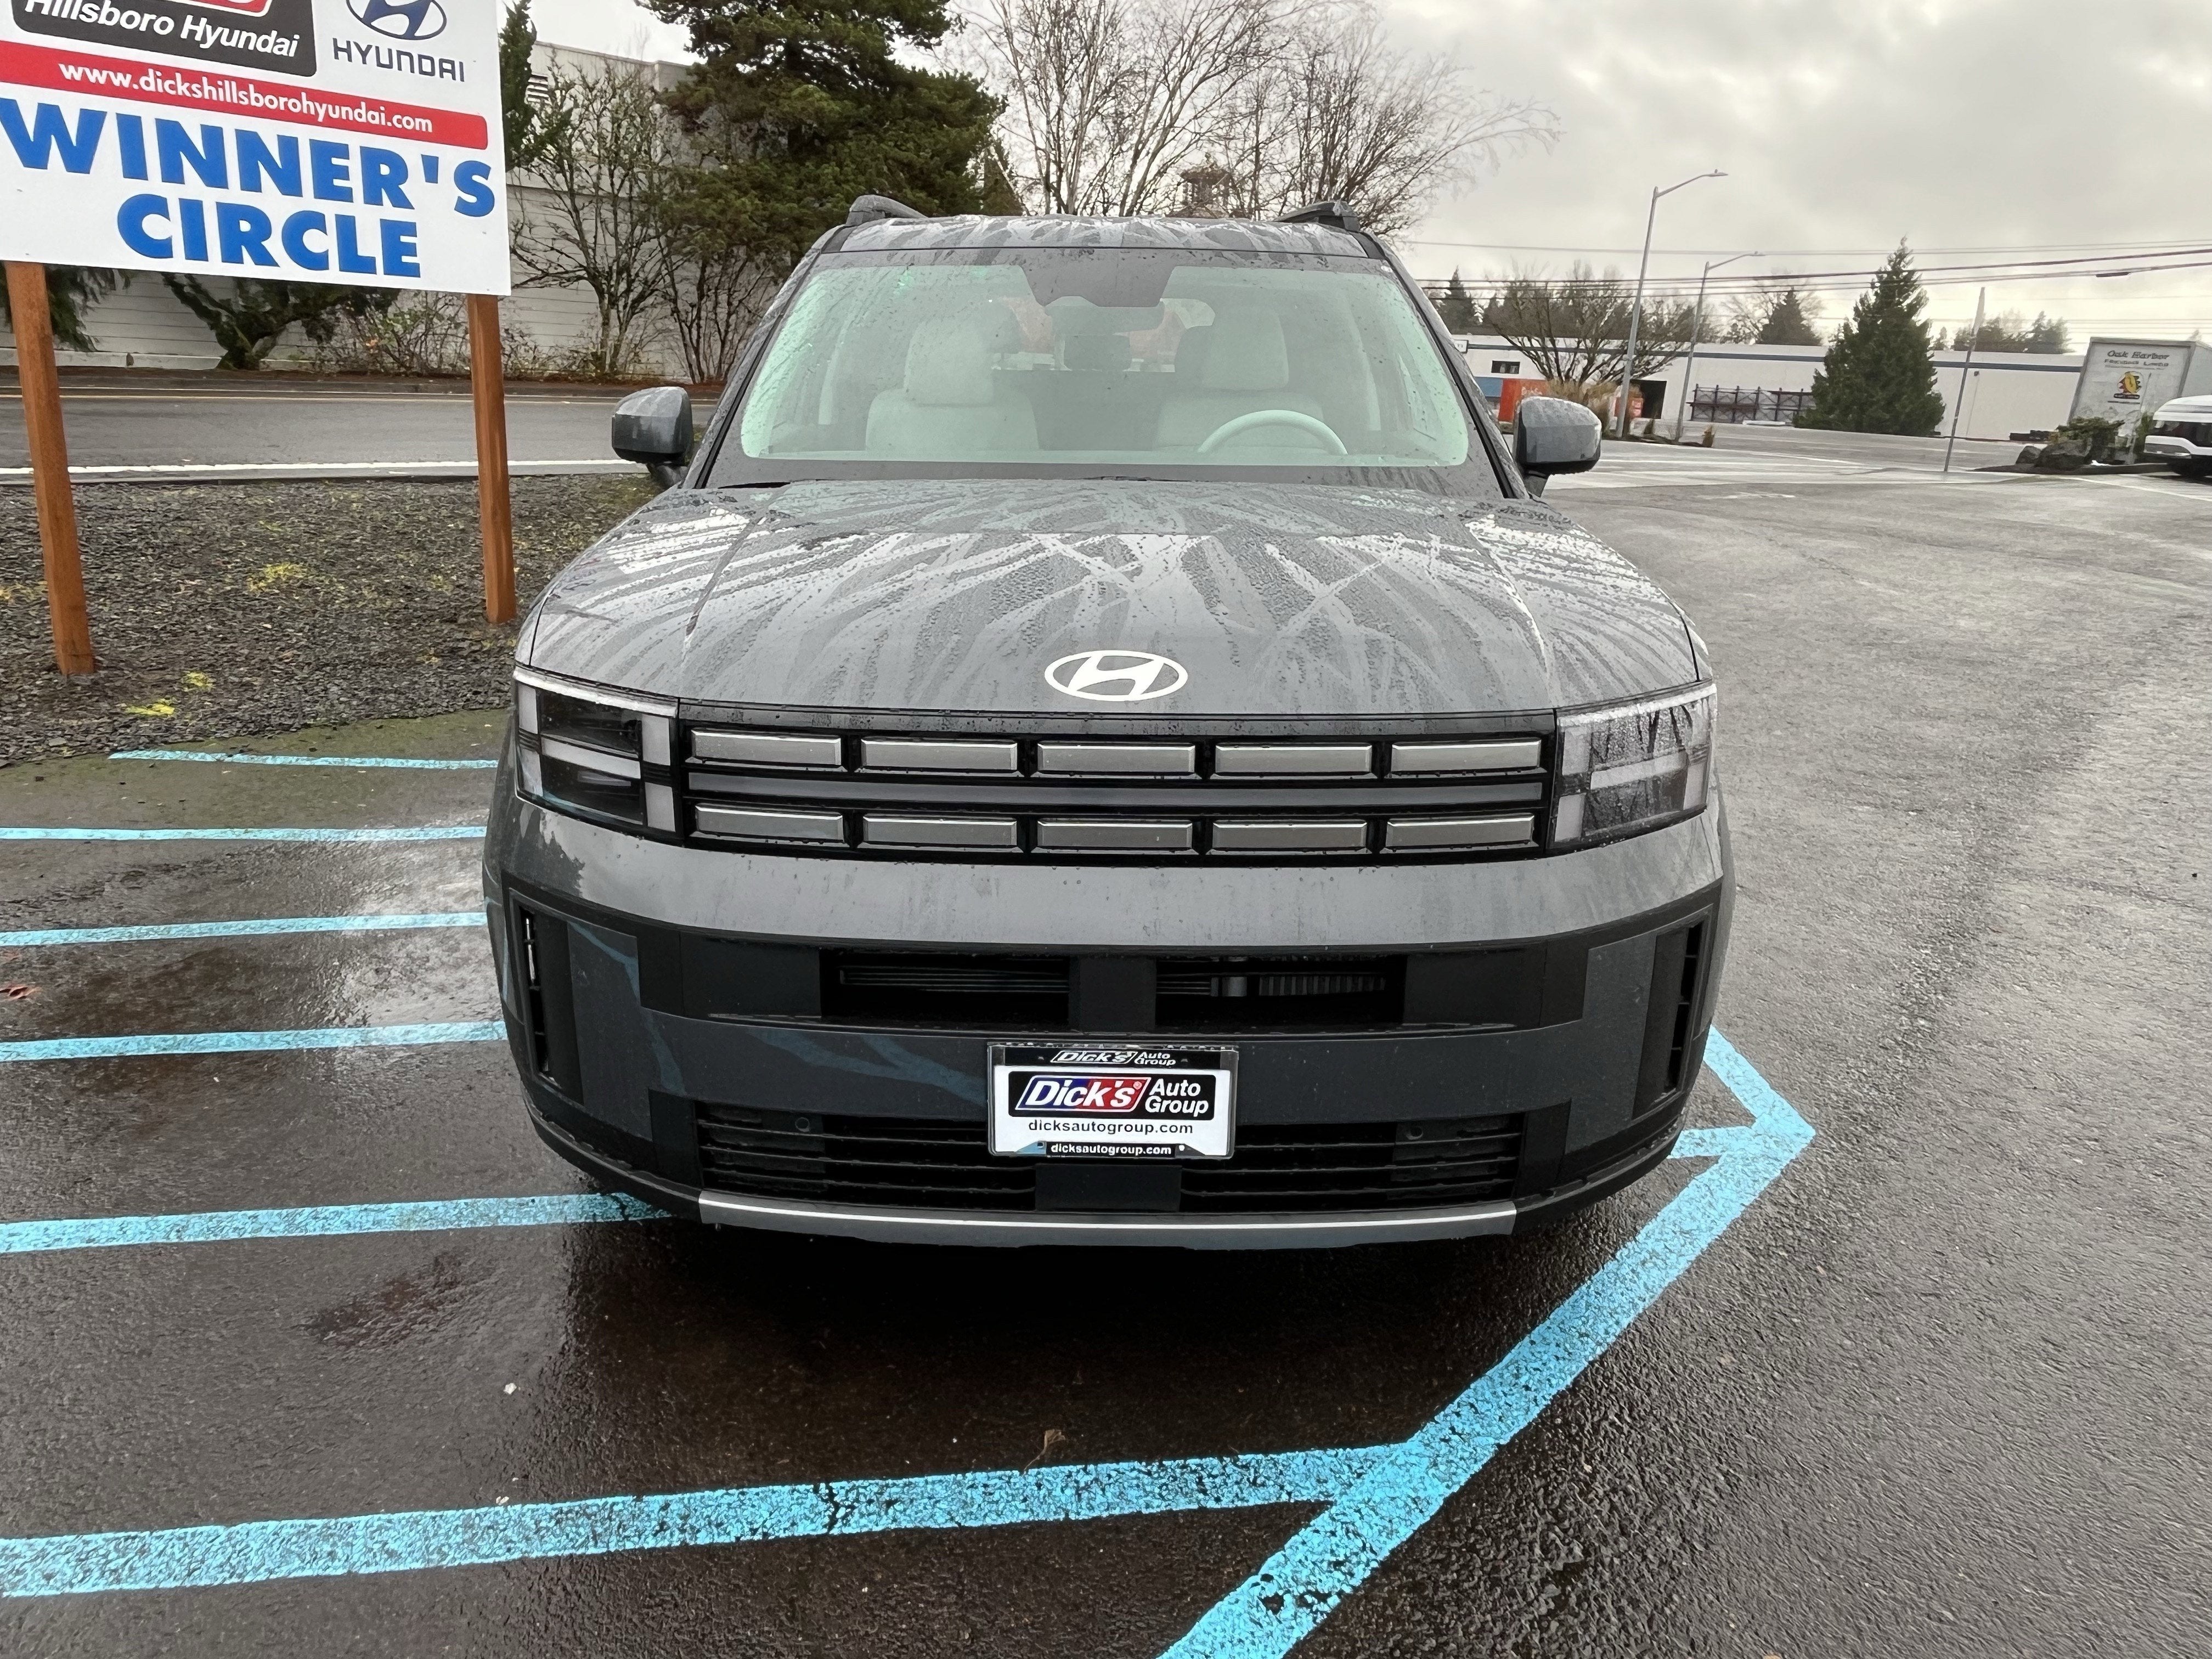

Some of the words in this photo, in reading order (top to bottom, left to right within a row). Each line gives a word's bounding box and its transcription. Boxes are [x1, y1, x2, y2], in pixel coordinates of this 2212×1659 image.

[25, 0, 174, 35] Hillsboro
[180, 15, 300, 57] Hyundai
[332, 38, 465, 82] HYUNDAI
[59, 61, 433, 133] www.dickshillsborohyundai.com
[0, 98, 495, 217] WINNER'S
[117, 194, 420, 279] CIRCLE
[1057, 1051, 1128, 1063] Dick's
[1135, 1057, 1176, 1065] Group
[1025, 1080, 1136, 1107] Dick's
[1149, 1078, 1200, 1096] Auto
[1145, 1096, 1209, 1117] Group
[1029, 1120, 1193, 1135] dicksautogroup.com
[1051, 1143, 1171, 1155] dicksautogroup.com
